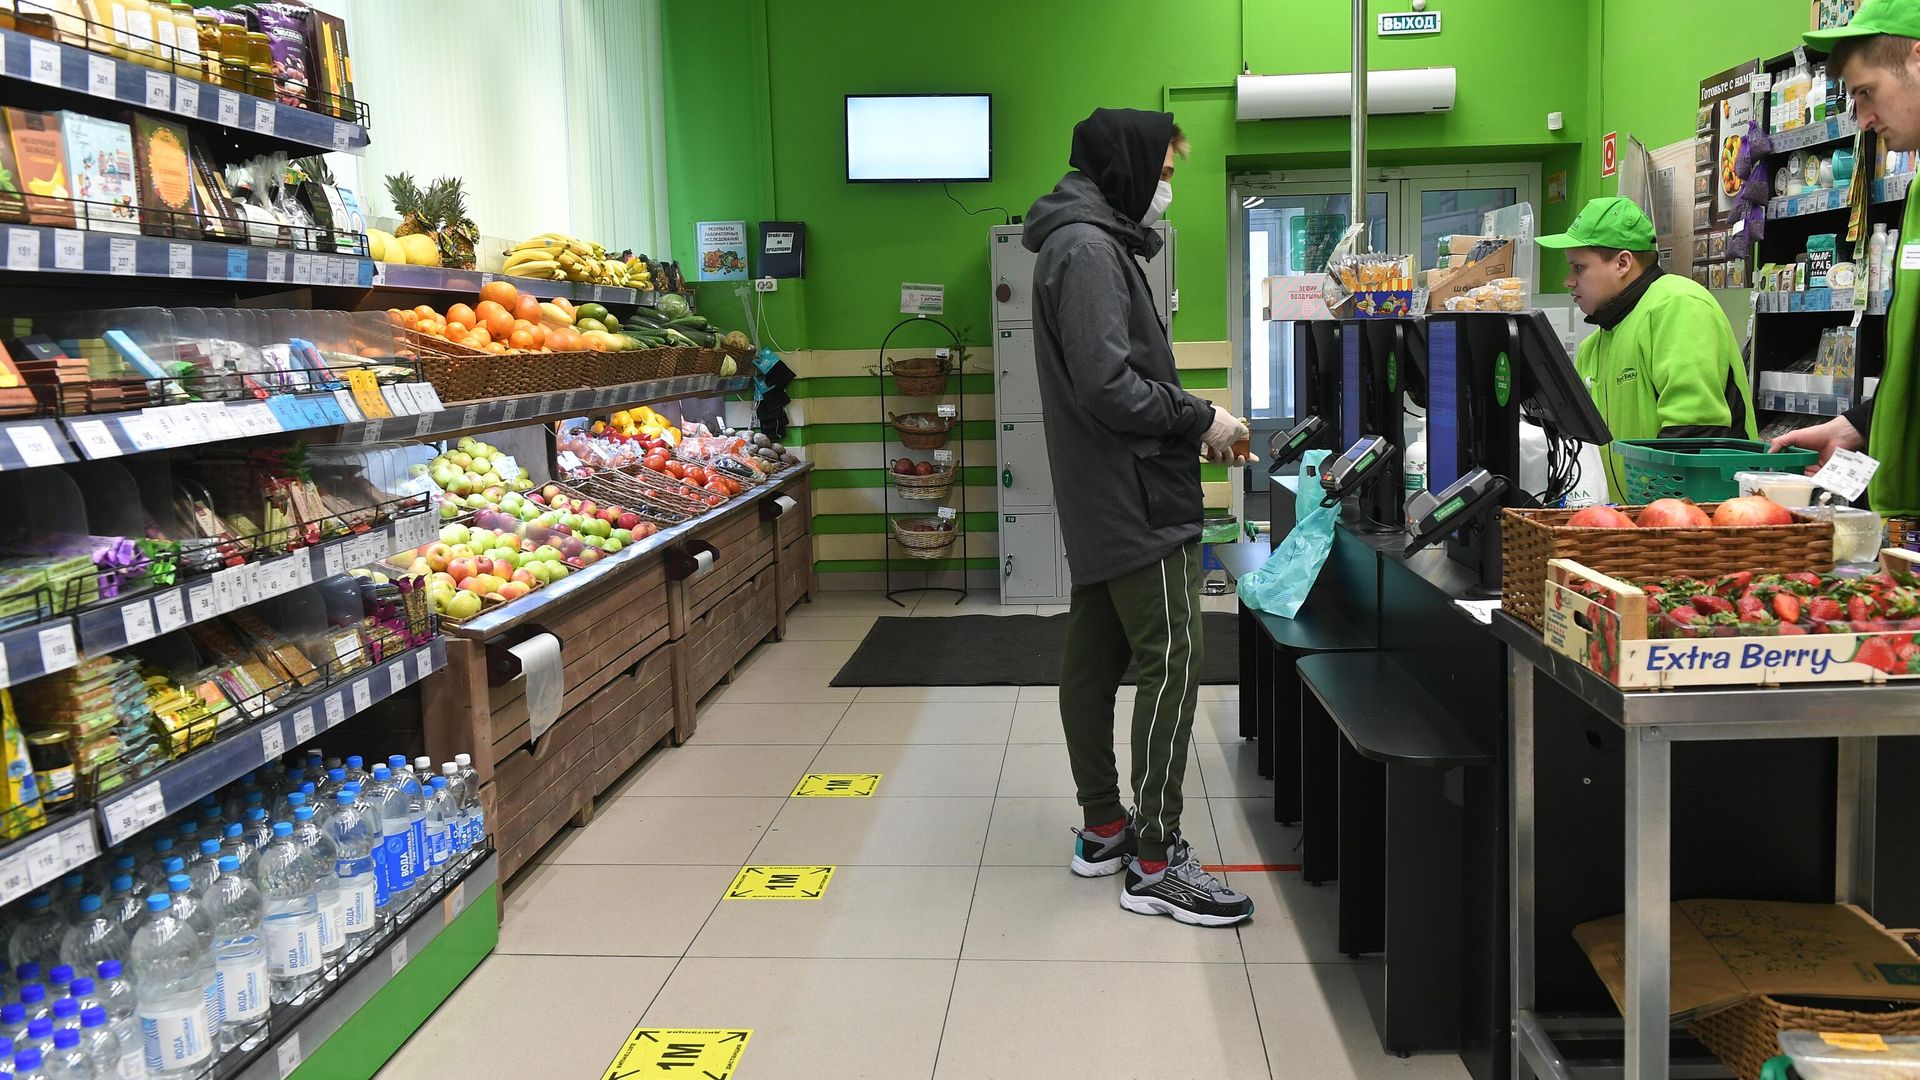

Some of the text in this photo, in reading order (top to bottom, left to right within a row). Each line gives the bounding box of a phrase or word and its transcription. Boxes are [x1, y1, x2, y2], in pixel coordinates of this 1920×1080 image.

[1383, 16, 1434, 30] ВЫХОД
[1701, 82, 1728, 101] Готовьте
[1729, 80, 1734, 90] с
[1809, 251, 1831, 261] МЫЛО-
[1811, 261, 1831, 270] КРАБ
[1646, 643, 1840, 675] Extra Berry
[824, 779, 853, 791] 1М
[400, 852, 409, 877] ВОДА
[765, 874, 800, 890] 1М
[290, 948, 298, 969] ВОДА
[238, 990, 246, 1012] ВОДА
[175, 1036, 183, 1060] ВОДА
[656, 1043, 706, 1070] 1М
